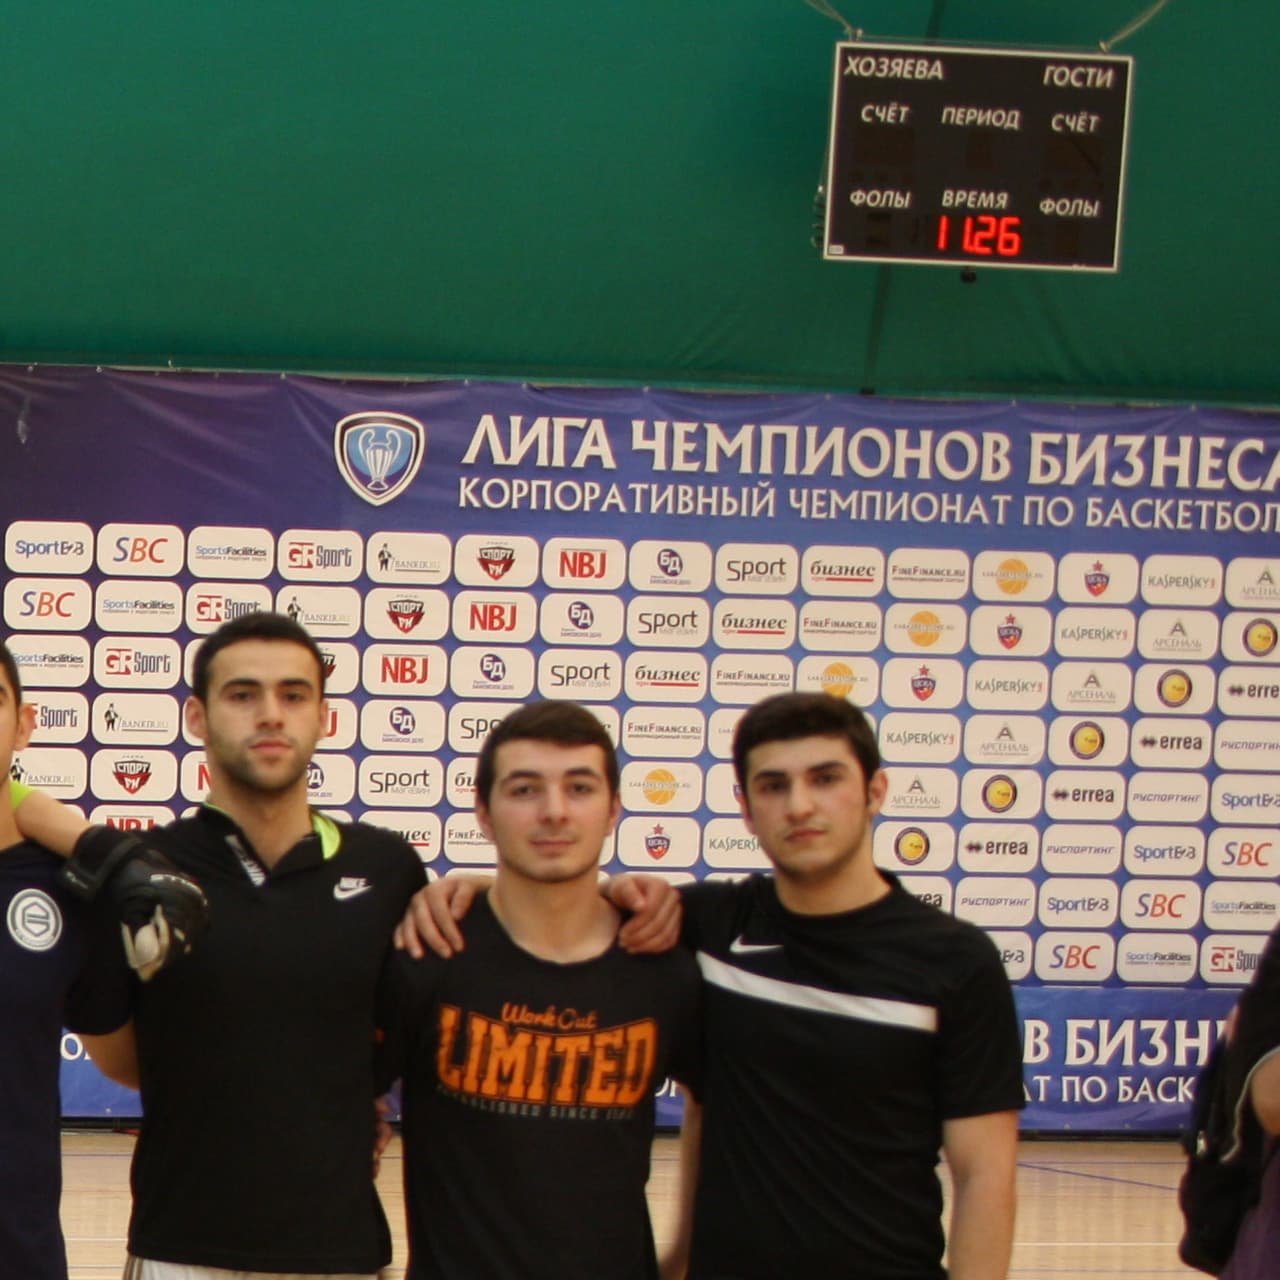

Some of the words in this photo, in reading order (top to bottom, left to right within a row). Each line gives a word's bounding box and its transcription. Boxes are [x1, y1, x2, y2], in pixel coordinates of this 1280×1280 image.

[844, 56, 944, 81] ХОЗЯЕВА
[1043, 65, 1114, 89] ГОСТИ
[861, 102, 910, 124] СЧЁТ
[941, 107, 1021, 130] ПЕРИОД
[1051, 111, 1100, 133] СЧЁТ
[849, 190, 912, 209] ФОЛЫ
[941, 190, 1009, 210] ВРЕМЯ
[1039, 199, 1100, 217] ФОЛЫ
[461, 414, 617, 470] ЛИГА
[632, 420, 1012, 482] ЧЕМПИОНОВ
[459, 476, 777, 519] КОРПОРАТИВНЫЙ
[790, 488, 1013, 527] ЧЕМПИОНАТ
[1023, 496, 1074, 528] ПО
[113, 537, 168, 563] SBC
[559, 551, 606, 578] NBJ
[727, 557, 787, 582] Sport
[810, 560, 876, 577] бизнес
[20, 591, 75, 617] SBC
[470, 604, 517, 631] NBJ
[638, 610, 698, 635] Sport
[722, 613, 787, 630] бизнес
[381, 656, 428, 683] NBJ
[551, 663, 610, 686] Sport
[635, 665, 701, 681] бизнес
[41, 706, 77, 729] Sport
[370, 770, 429, 792] Sport
[1222, 842, 1272, 866] SBC
[1135, 893, 1186, 918] SBC
[1050, 945, 1101, 969] SBC
[438, 1003, 657, 1107] LIMITED
[1062, 1076, 1107, 1103] ПО
